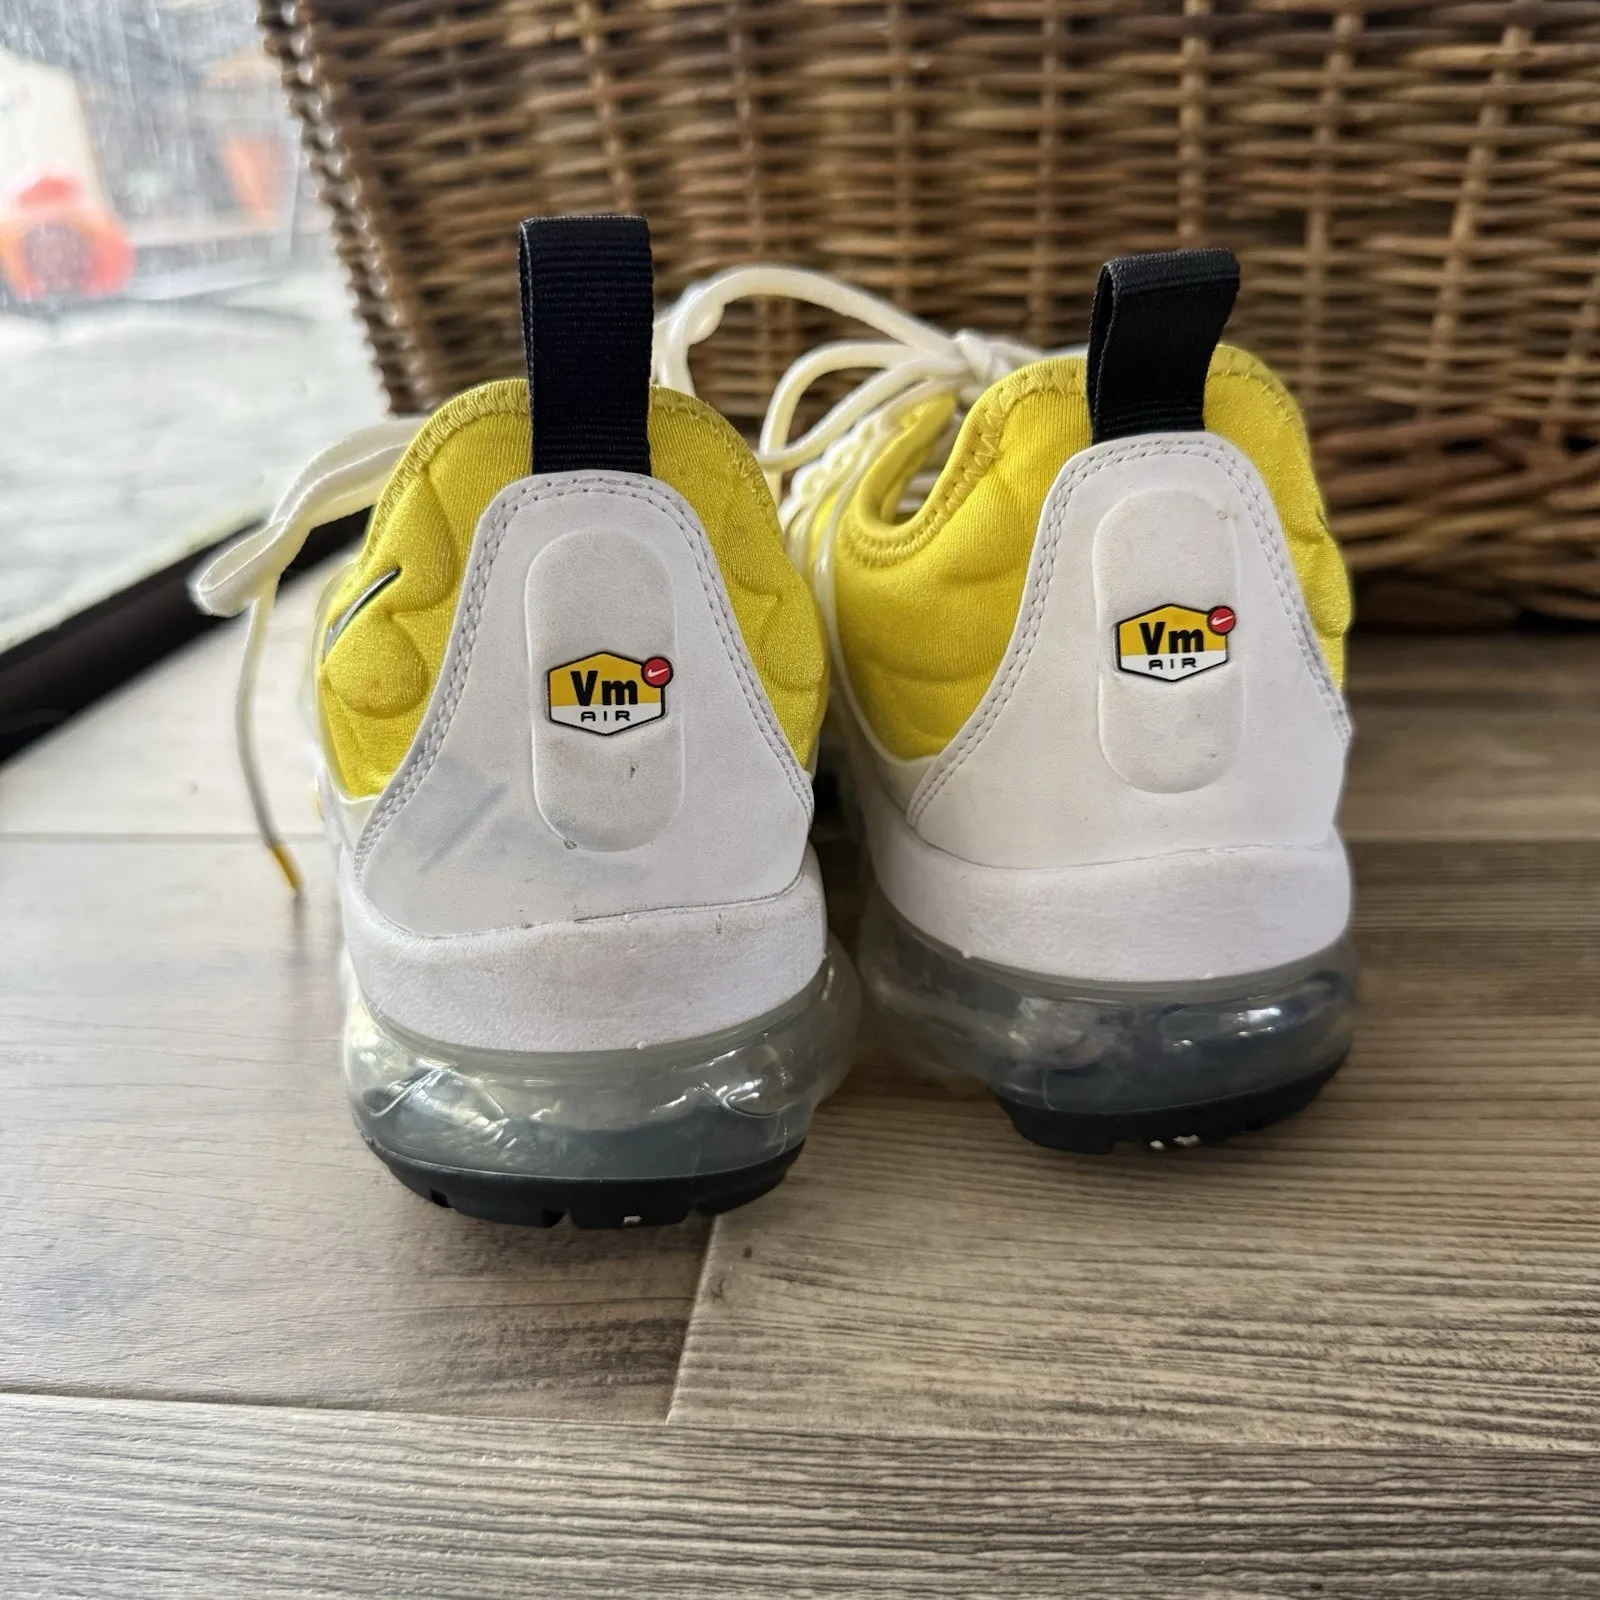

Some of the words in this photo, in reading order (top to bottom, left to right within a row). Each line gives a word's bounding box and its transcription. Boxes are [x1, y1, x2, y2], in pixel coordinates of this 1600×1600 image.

[1139, 622, 1204, 655] Vm
[1149, 658, 1197, 670] AIR
[570, 671, 638, 706] Vm
[581, 710, 630, 722] AIR
